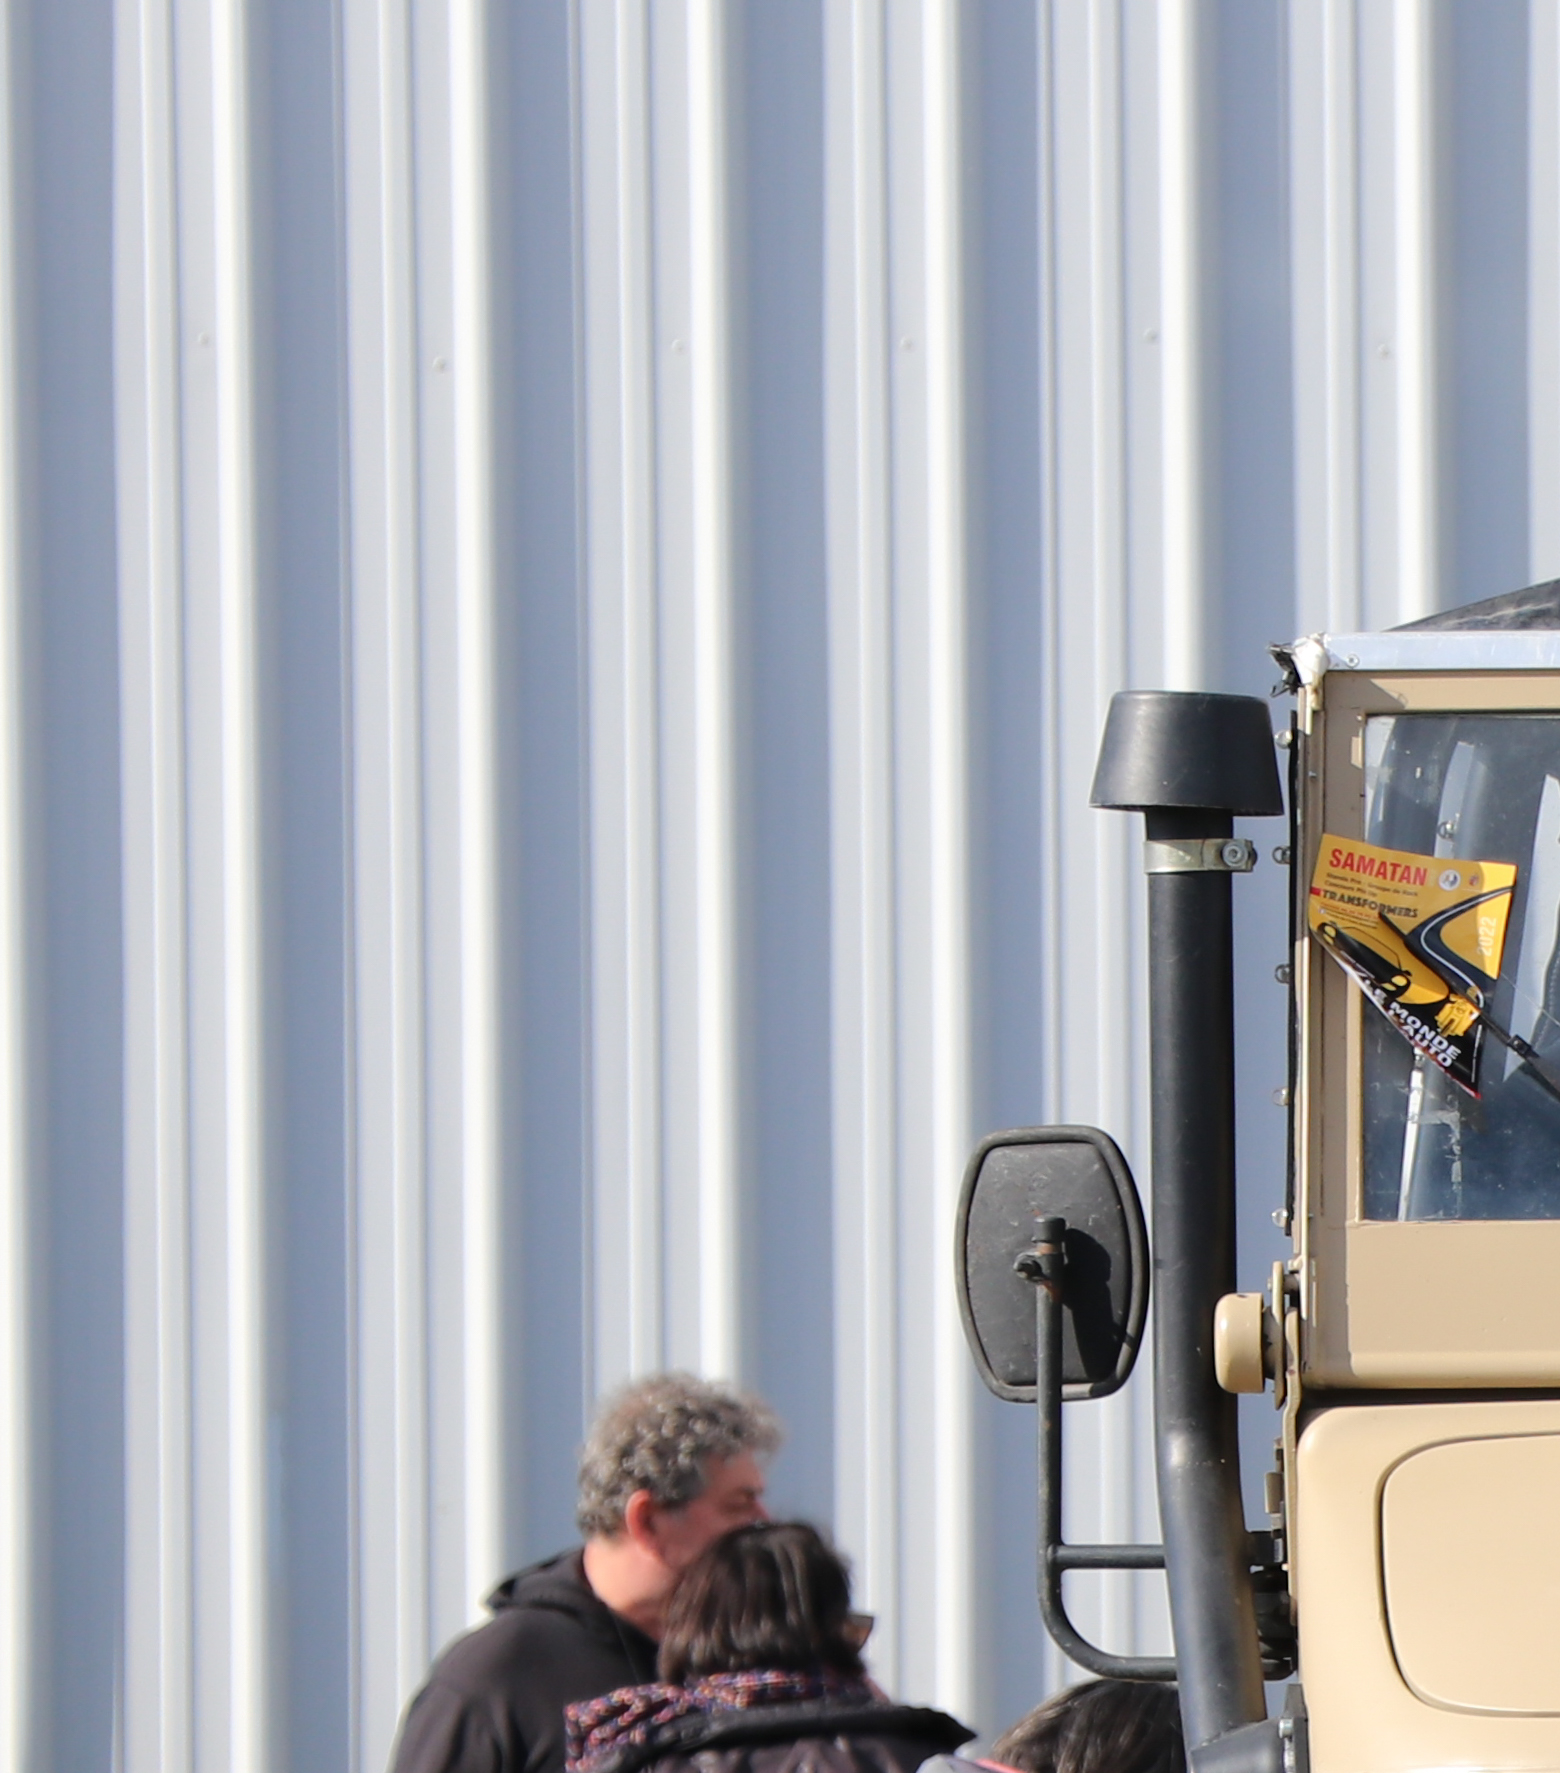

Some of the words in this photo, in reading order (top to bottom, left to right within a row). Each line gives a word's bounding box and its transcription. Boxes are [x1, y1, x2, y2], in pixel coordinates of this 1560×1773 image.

[1329, 848, 1428, 886] SAMATAN
[1322, 889, 1418, 918] TRANSFORMERS
[1476, 916, 1498, 957] 2022
[1389, 1001, 1461, 1060] MONDE
